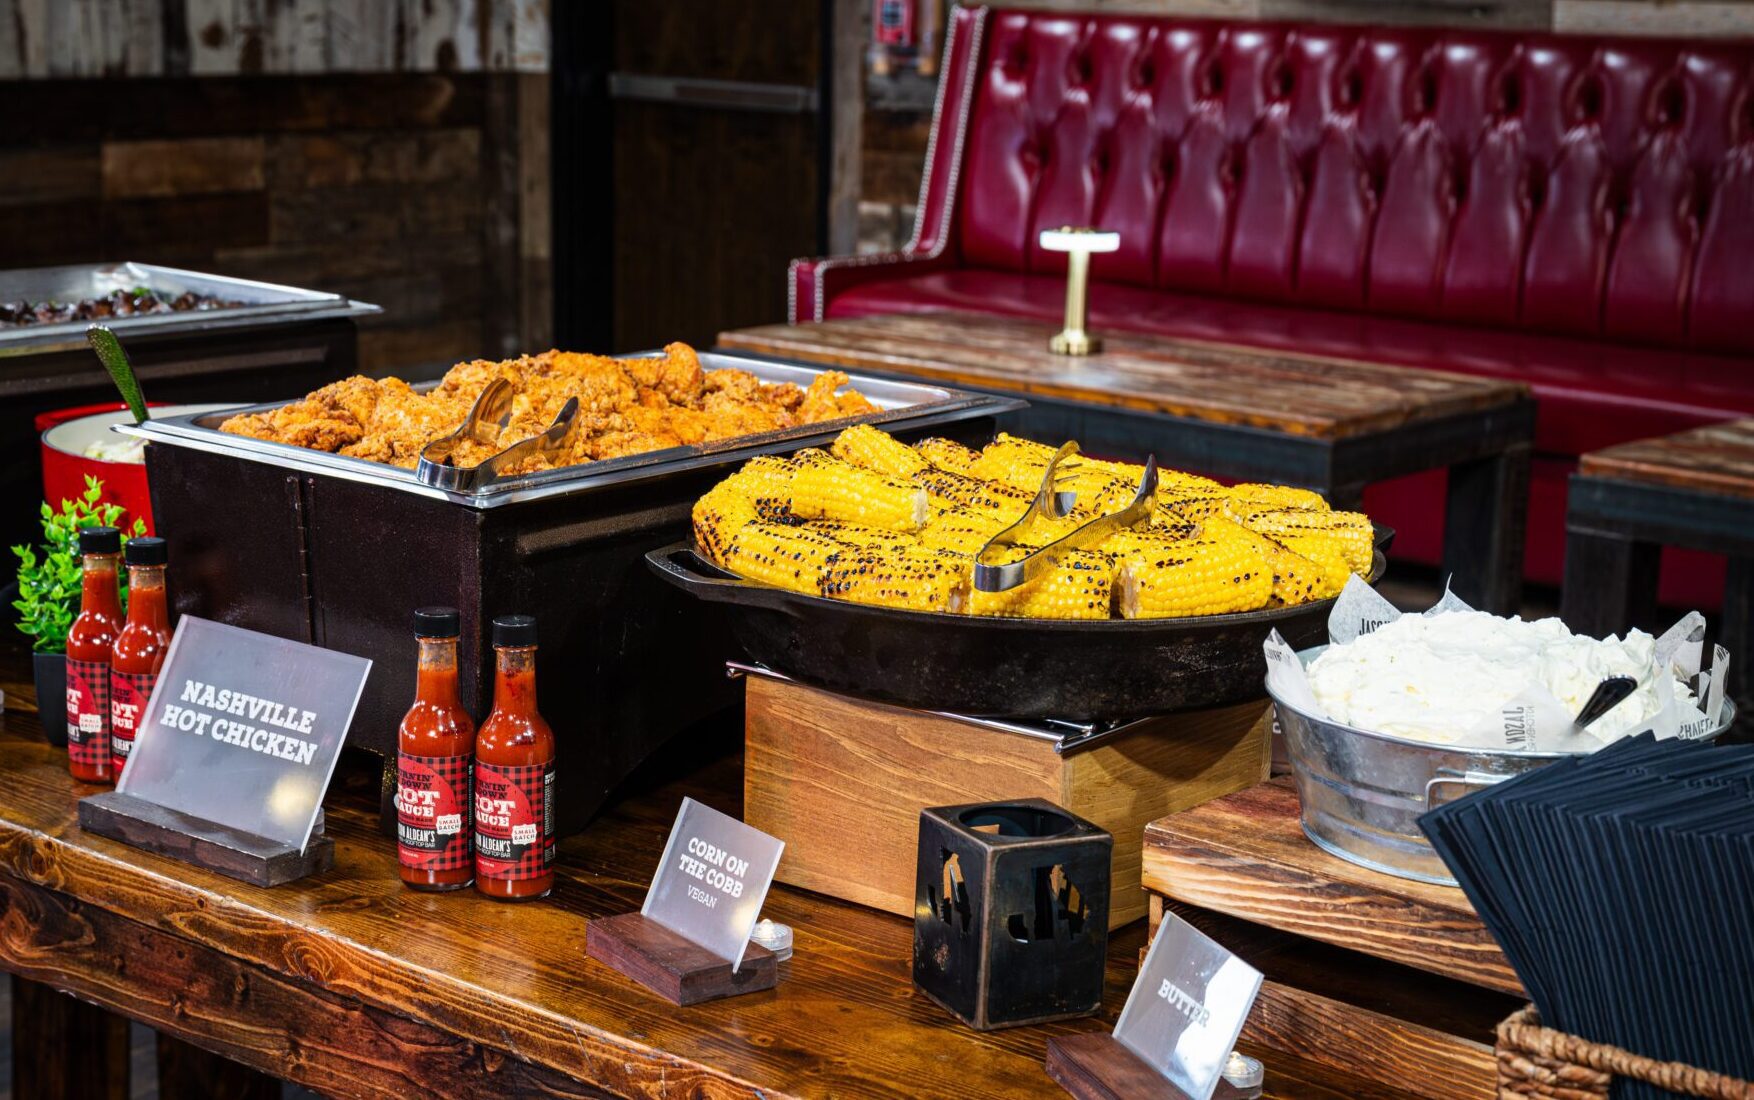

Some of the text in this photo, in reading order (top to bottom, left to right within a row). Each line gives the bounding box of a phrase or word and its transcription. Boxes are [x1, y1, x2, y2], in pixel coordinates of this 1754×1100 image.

[111, 700, 139, 720] OT
[180, 679, 317, 734] NASHVILLE
[160, 703, 318, 765] HOT CHICKEN
[398, 801, 434, 818] AUCE
[475, 809, 510, 827] AUCE
[405, 826, 435, 843] ALDEAN'S
[482, 835, 511, 852] ALDEAN'S
[688, 837, 749, 878] CORN ON
[678, 854, 744, 898] THE COBB
[687, 884, 718, 909] VEGAN
[1157, 978, 1210, 1028] BUTTER
